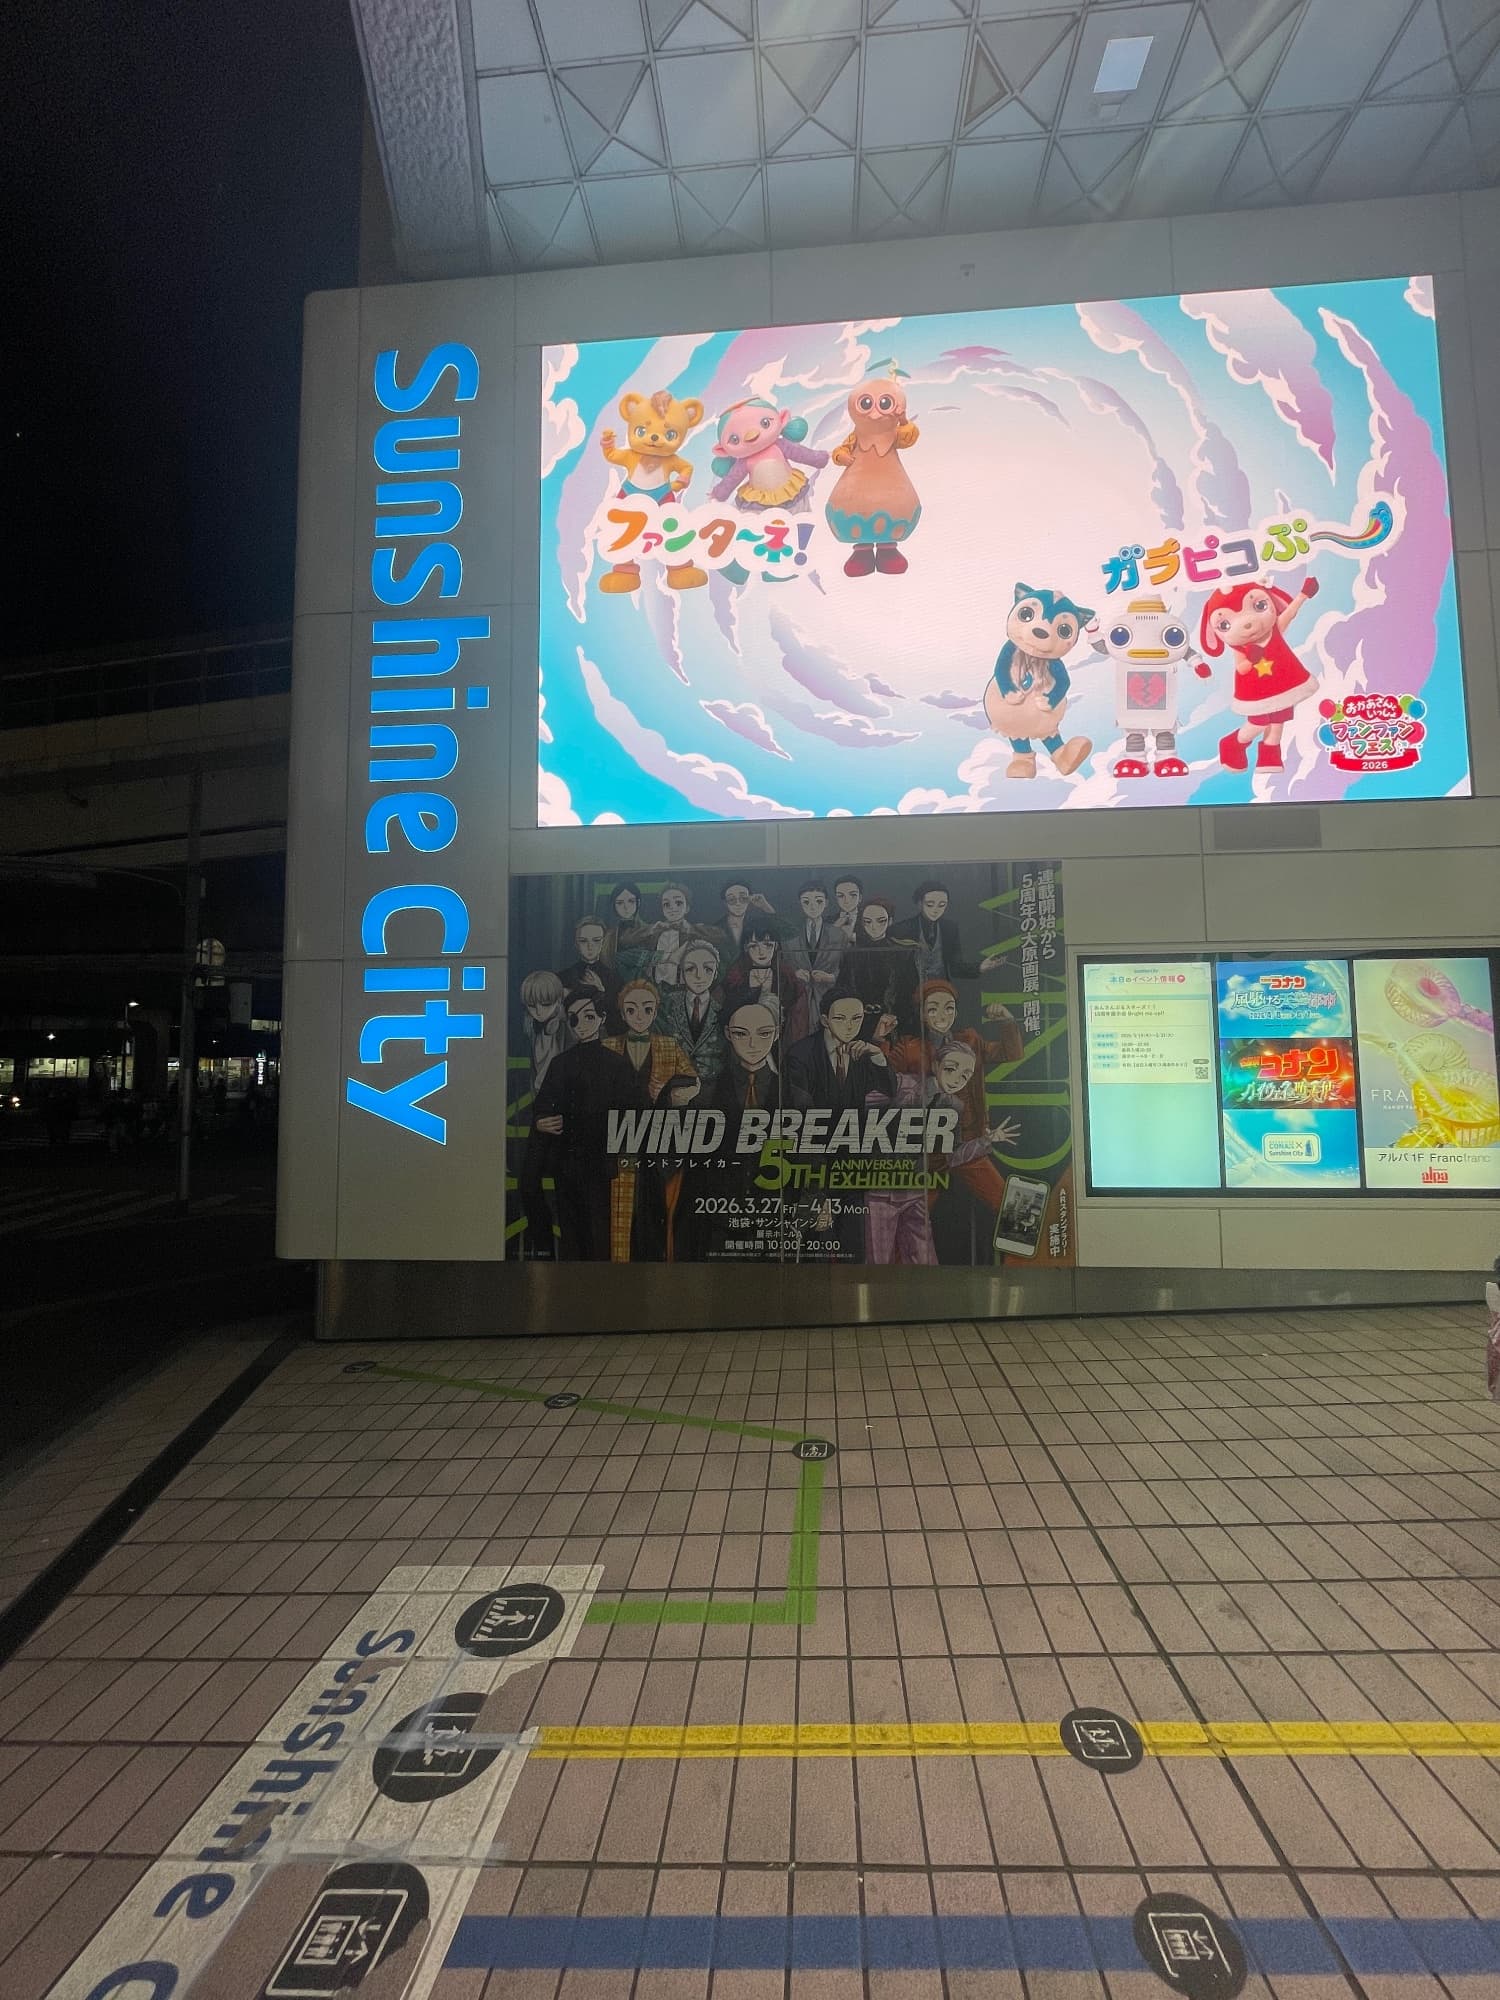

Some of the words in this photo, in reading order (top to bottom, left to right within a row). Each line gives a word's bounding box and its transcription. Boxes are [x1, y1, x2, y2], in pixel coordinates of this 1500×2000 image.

[366, 343, 490, 852] Sunshine
[1345, 698, 1398, 715] おかあさんと
[1366, 709, 1397, 719] いっしょ
[1333, 721, 1413, 739] ファンファン
[1351, 738, 1394, 755] フェス
[1361, 761, 1388, 770] 2026
[1037, 869, 1057, 961] 連載開始から
[606, 1109, 726, 1154] WIND
[735, 1107, 959, 1154] BREAKER
[620, 1158, 741, 1168] ウィンドブレイカー
[831, 1159, 917, 1171] ANNIVERSARY
[1430, 1152, 1490, 1163] Francfranc
[829, 1171, 949, 1190] EXHIBITION
[1421, 1166, 1448, 1183] alpa
[725, 1240, 764, 1250] 開催時間
